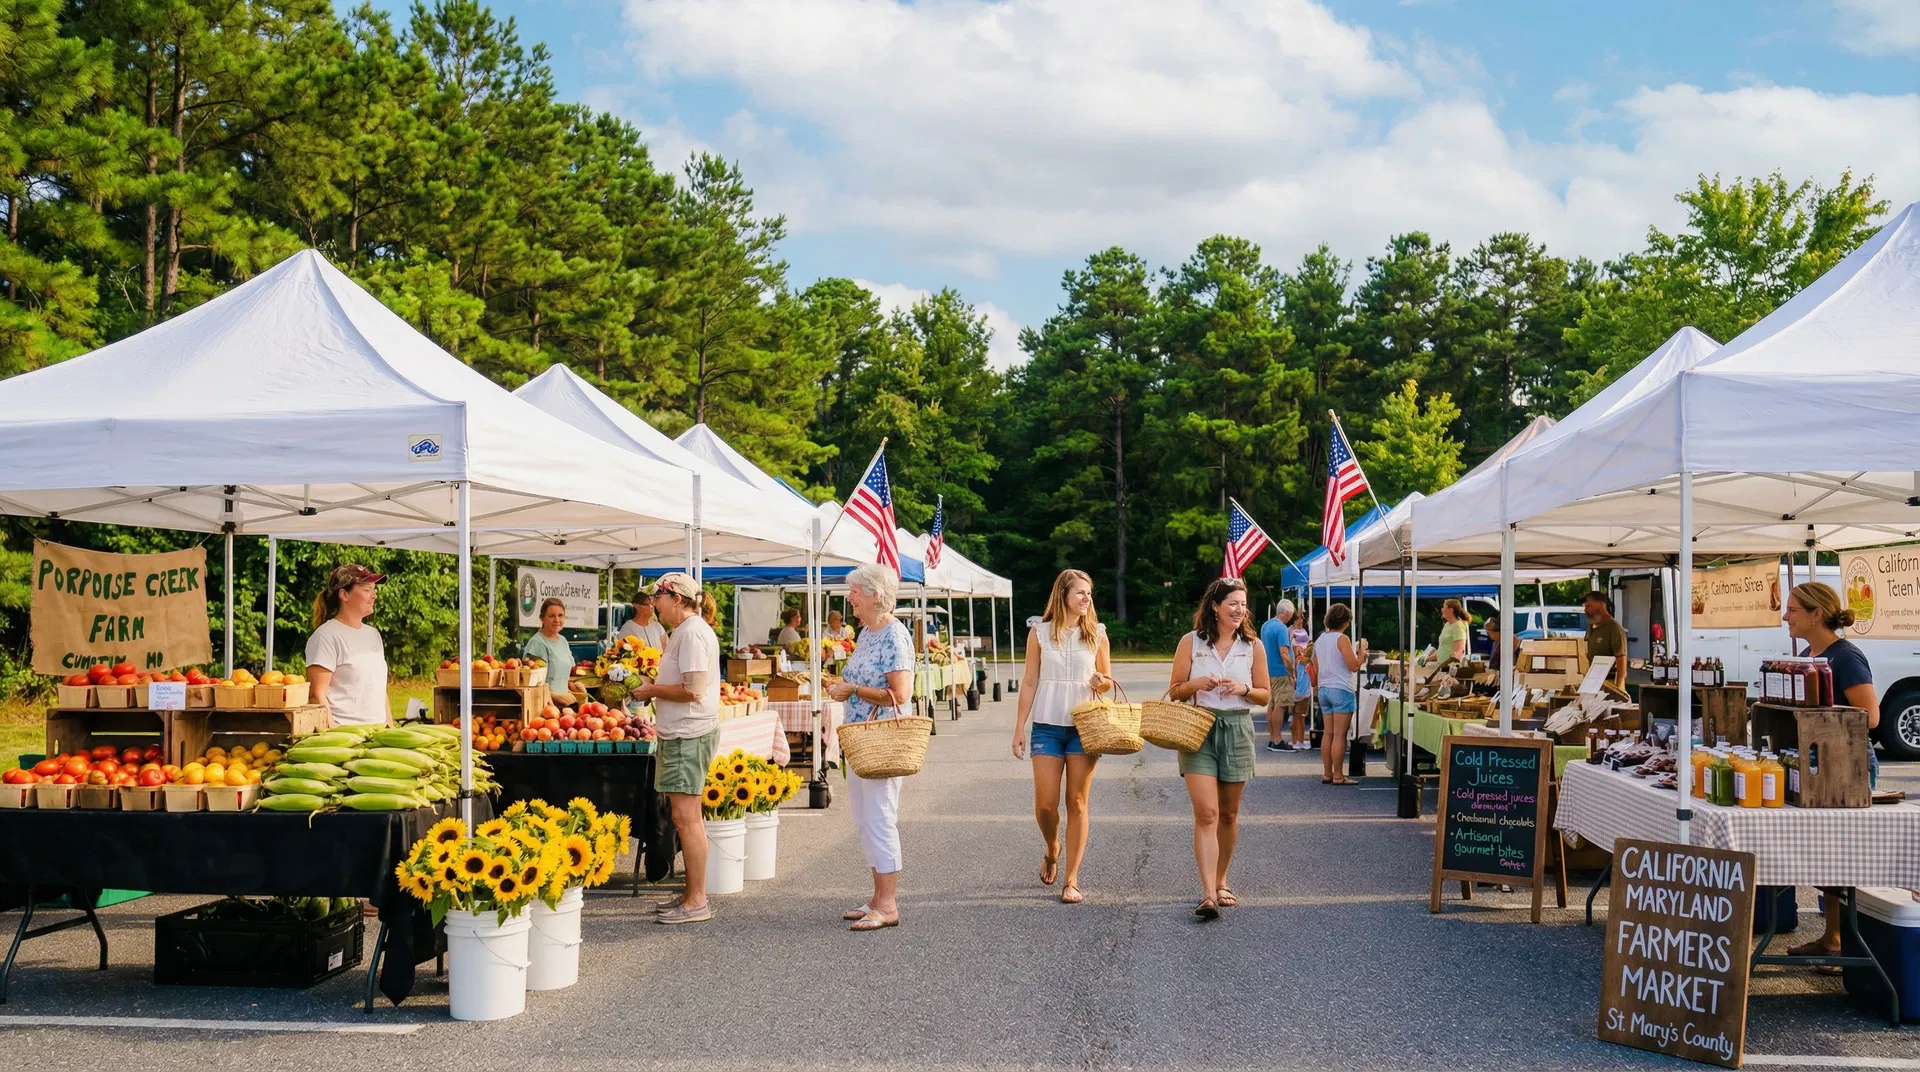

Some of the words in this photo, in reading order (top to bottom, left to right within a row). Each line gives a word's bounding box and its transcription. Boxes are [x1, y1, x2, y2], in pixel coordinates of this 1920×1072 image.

[38, 559, 137, 600] PORPOISE
[145, 567, 199, 597] CREEK
[88, 614, 145, 643] FARM
[1455, 750, 1483, 767] Cold
[1488, 751, 1536, 769] Pressed
[1467, 767, 1514, 786] Juices
[1456, 788, 1474, 800] Cold
[1454, 842, 1496, 857] gourmet
[1498, 844, 1524, 859] bites
[1455, 827, 1503, 844] Artisanal
[1620, 846, 1746, 892] CALIFORNIA
[1625, 883, 1733, 923] MARYLAND
[1617, 920, 1731, 973] FARMERS
[1620, 964, 1725, 1015] MARKET
[1605, 1007, 1626, 1032] St.
[1630, 1011, 1679, 1048] Mary's
[1682, 1022, 1734, 1061] County
